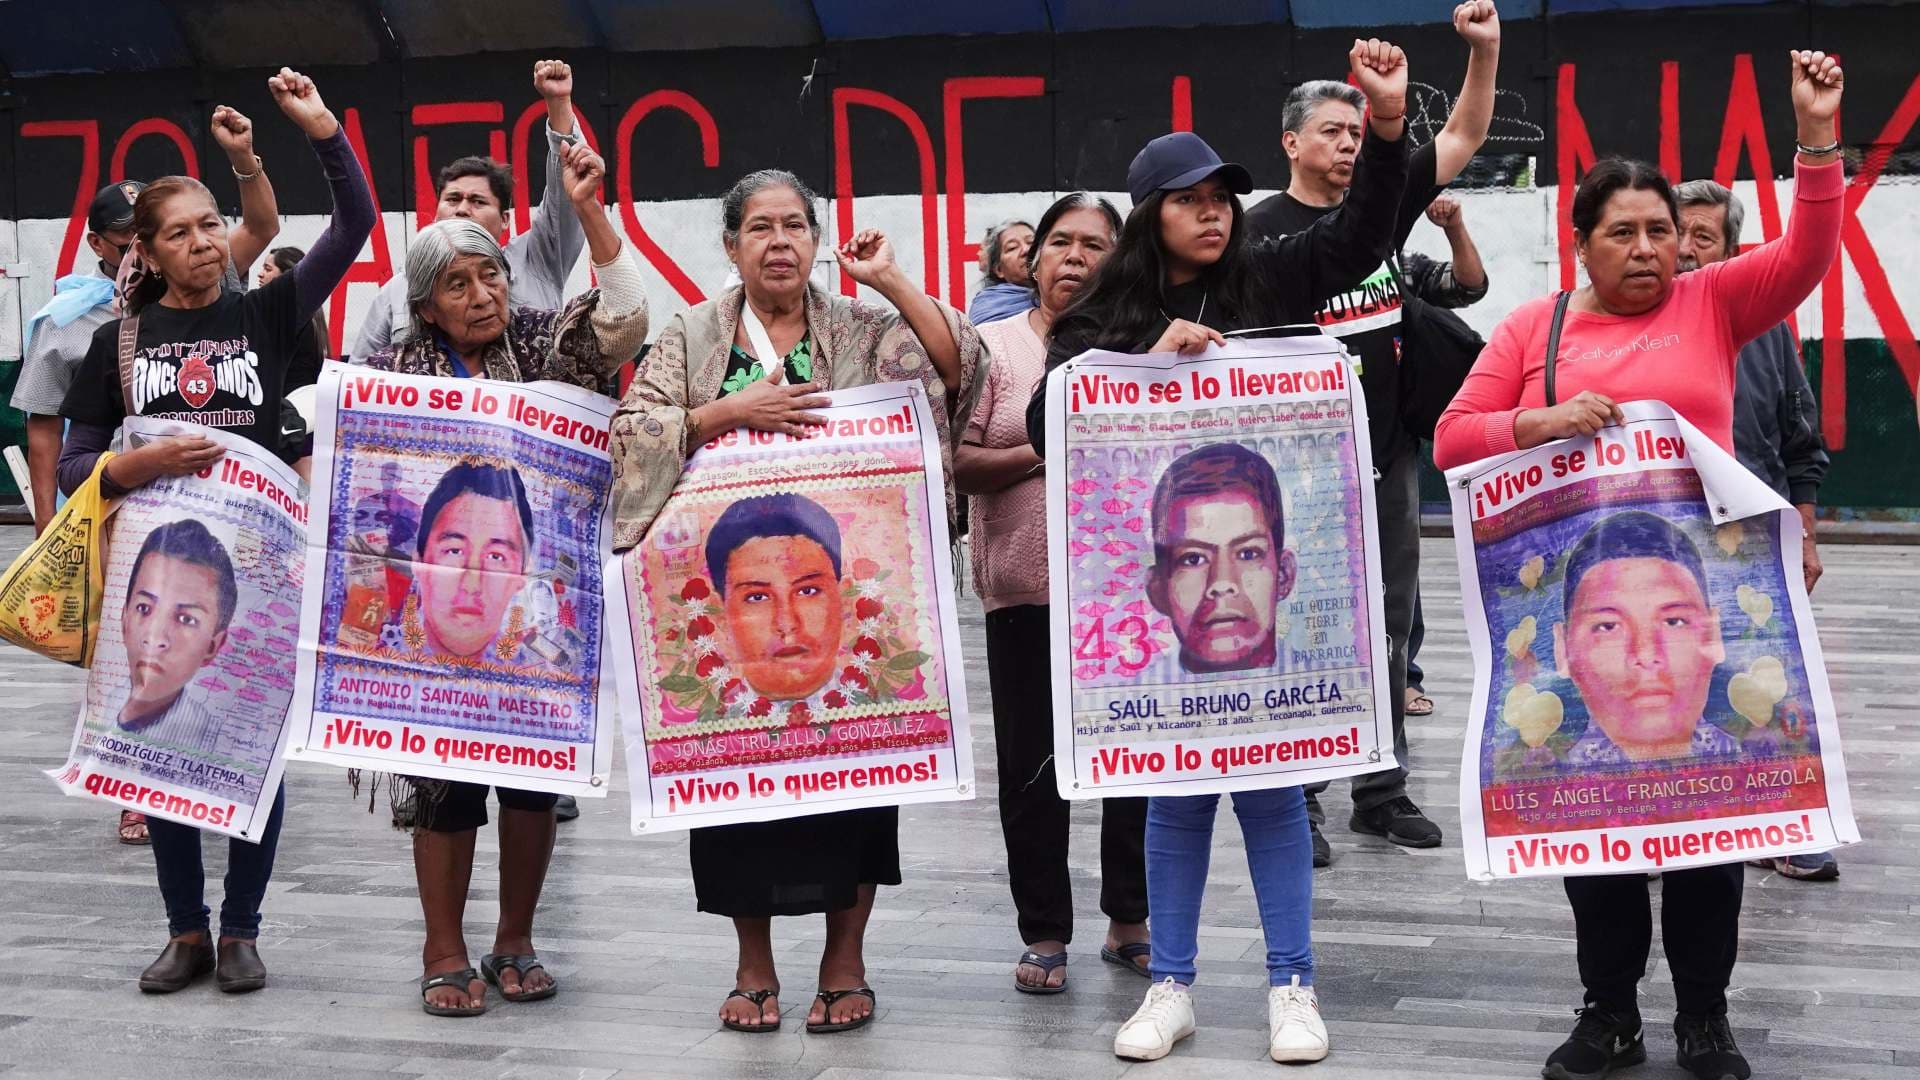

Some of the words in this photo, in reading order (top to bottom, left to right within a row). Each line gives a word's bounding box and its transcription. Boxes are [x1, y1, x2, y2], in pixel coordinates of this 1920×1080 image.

[833, 76, 1045, 313] DE
[139, 335, 249, 360] YOTZINAP
[133, 357, 177, 414] ONCE
[216, 351, 264, 406] AÑOS
[186, 379, 208, 395] 43
[1072, 374, 1139, 412] ¡Vivo
[1148, 381, 1182, 404] se
[1192, 371, 1220, 400] lo
[1229, 362, 1344, 397] llevaron!
[191, 408, 255, 427] sombras
[344, 377, 418, 408] ¡Vivo
[428, 388, 463, 411] se
[472, 387, 498, 415] lo
[507, 394, 611, 453] llevaron
[786, 405, 913, 443] evaron!
[1238, 415, 1266, 426] quiero
[1272, 412, 1296, 422] saber
[221, 459, 310, 526] llevaron!
[1475, 465, 1543, 518] ¡Vivo
[1551, 450, 1586, 478] se
[1594, 437, 1625, 467] lo
[1075, 615, 1152, 671] 43
[338, 677, 411, 700] ANTONIO
[420, 686, 489, 710] SANTANA
[498, 696, 573, 719] MAESTRO
[353, 696, 364, 705] de
[420, 705, 447, 716] Nieto
[450, 708, 460, 717] de
[1077, 726, 1100, 736] Hijo
[1104, 724, 1116, 733] de
[1120, 722, 1142, 732] Saúl
[1157, 720, 1202, 730] Nicanora
[1217, 717, 1228, 726] 18
[1233, 715, 1254, 725] años
[1268, 709, 1317, 721] Tecoanapa,
[1321, 704, 1367, 715] Guerrero,
[1108, 694, 1165, 721] SAÚL
[1181, 692, 1251, 717] BRUNO
[1264, 679, 1342, 709] GARCÍA
[101, 736, 173, 766] RODRÍGUEZ
[179, 758, 246, 786] TLATEMPA
[323, 718, 392, 749] ¡Vivo
[400, 726, 426, 753] lo
[434, 737, 576, 772] queremos!
[673, 736, 727, 758] JONÁS
[739, 728, 826, 752] TRUJILLO
[837, 718, 926, 741] GONZÁLEZ
[678, 761, 687, 769] de
[692, 758, 728, 768] Yolanda,
[733, 753, 766, 763] hermano
[770, 751, 780, 760] de
[840, 743, 859, 752] años
[1091, 747, 1165, 784] ¡Vivo
[1175, 744, 1202, 771] lo
[1211, 727, 1360, 774] queremos!
[85, 773, 236, 827] queremos!
[668, 777, 739, 813] ¡Vivo
[748, 772, 775, 798] lo
[784, 754, 939, 801] queremos!
[1491, 789, 1540, 812] LUÍS
[1551, 785, 1614, 807] ÁNGEL
[1627, 775, 1734, 800] FRANCISCO
[1745, 767, 1817, 789] ARZOLA
[1517, 813, 1541, 823] Hijo
[1546, 810, 1557, 819] de
[1562, 808, 1601, 818] Lorenzo
[1723, 796, 1740, 805] San
[1507, 838, 1590, 874] ¡Vivo
[1600, 833, 1631, 863] lo
[1643, 814, 1814, 867] queremos!
